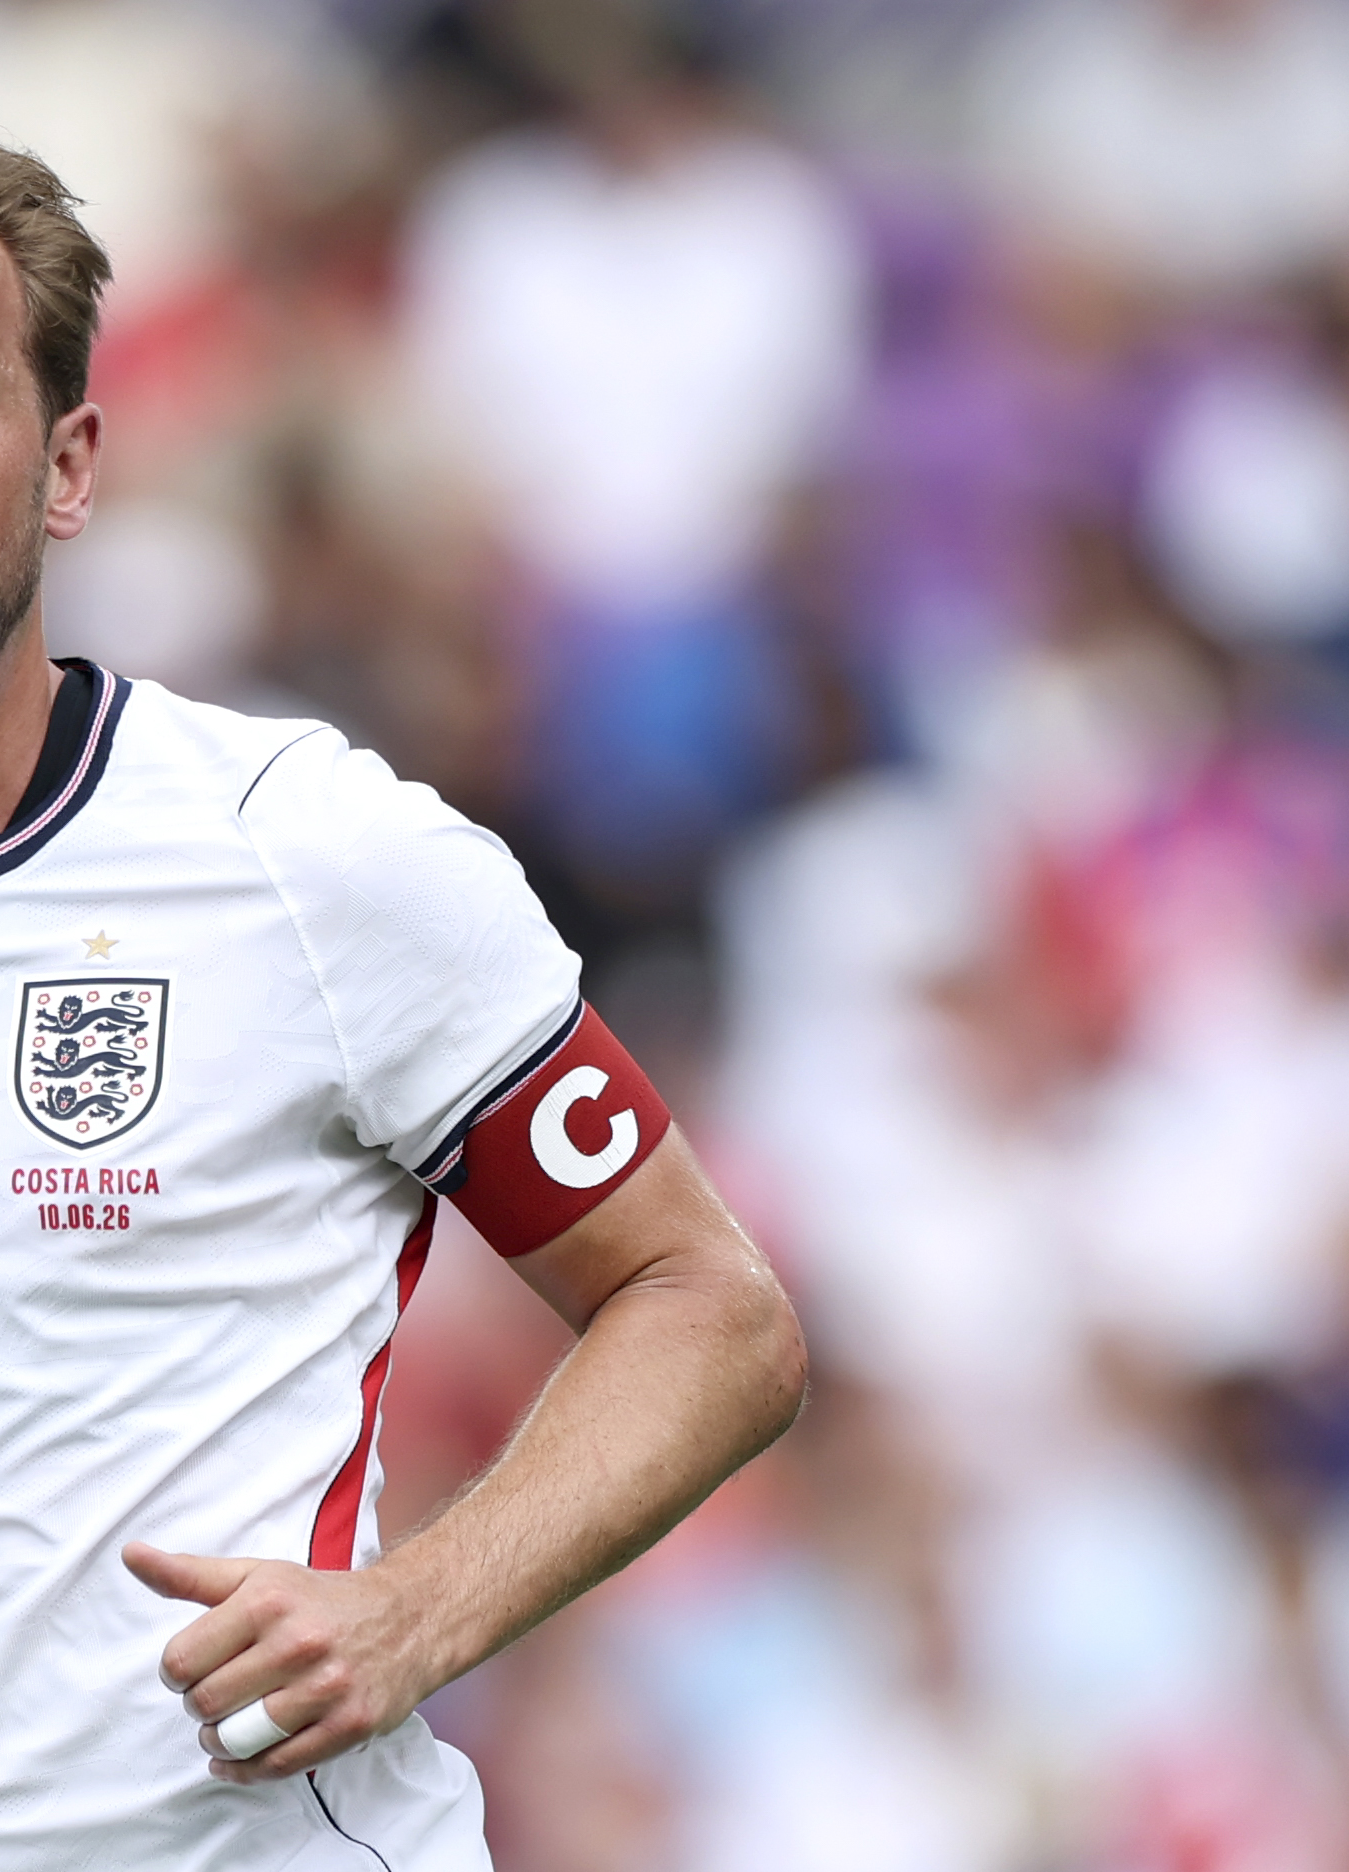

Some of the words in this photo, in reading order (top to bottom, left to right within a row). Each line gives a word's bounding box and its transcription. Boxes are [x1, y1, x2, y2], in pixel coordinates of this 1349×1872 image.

[530, 1065, 640, 1189] C
[11, 1168, 89, 1195] COSTA
[98, 1168, 160, 1195] RICA
[38, 1203, 130, 1231] 10.06.26
